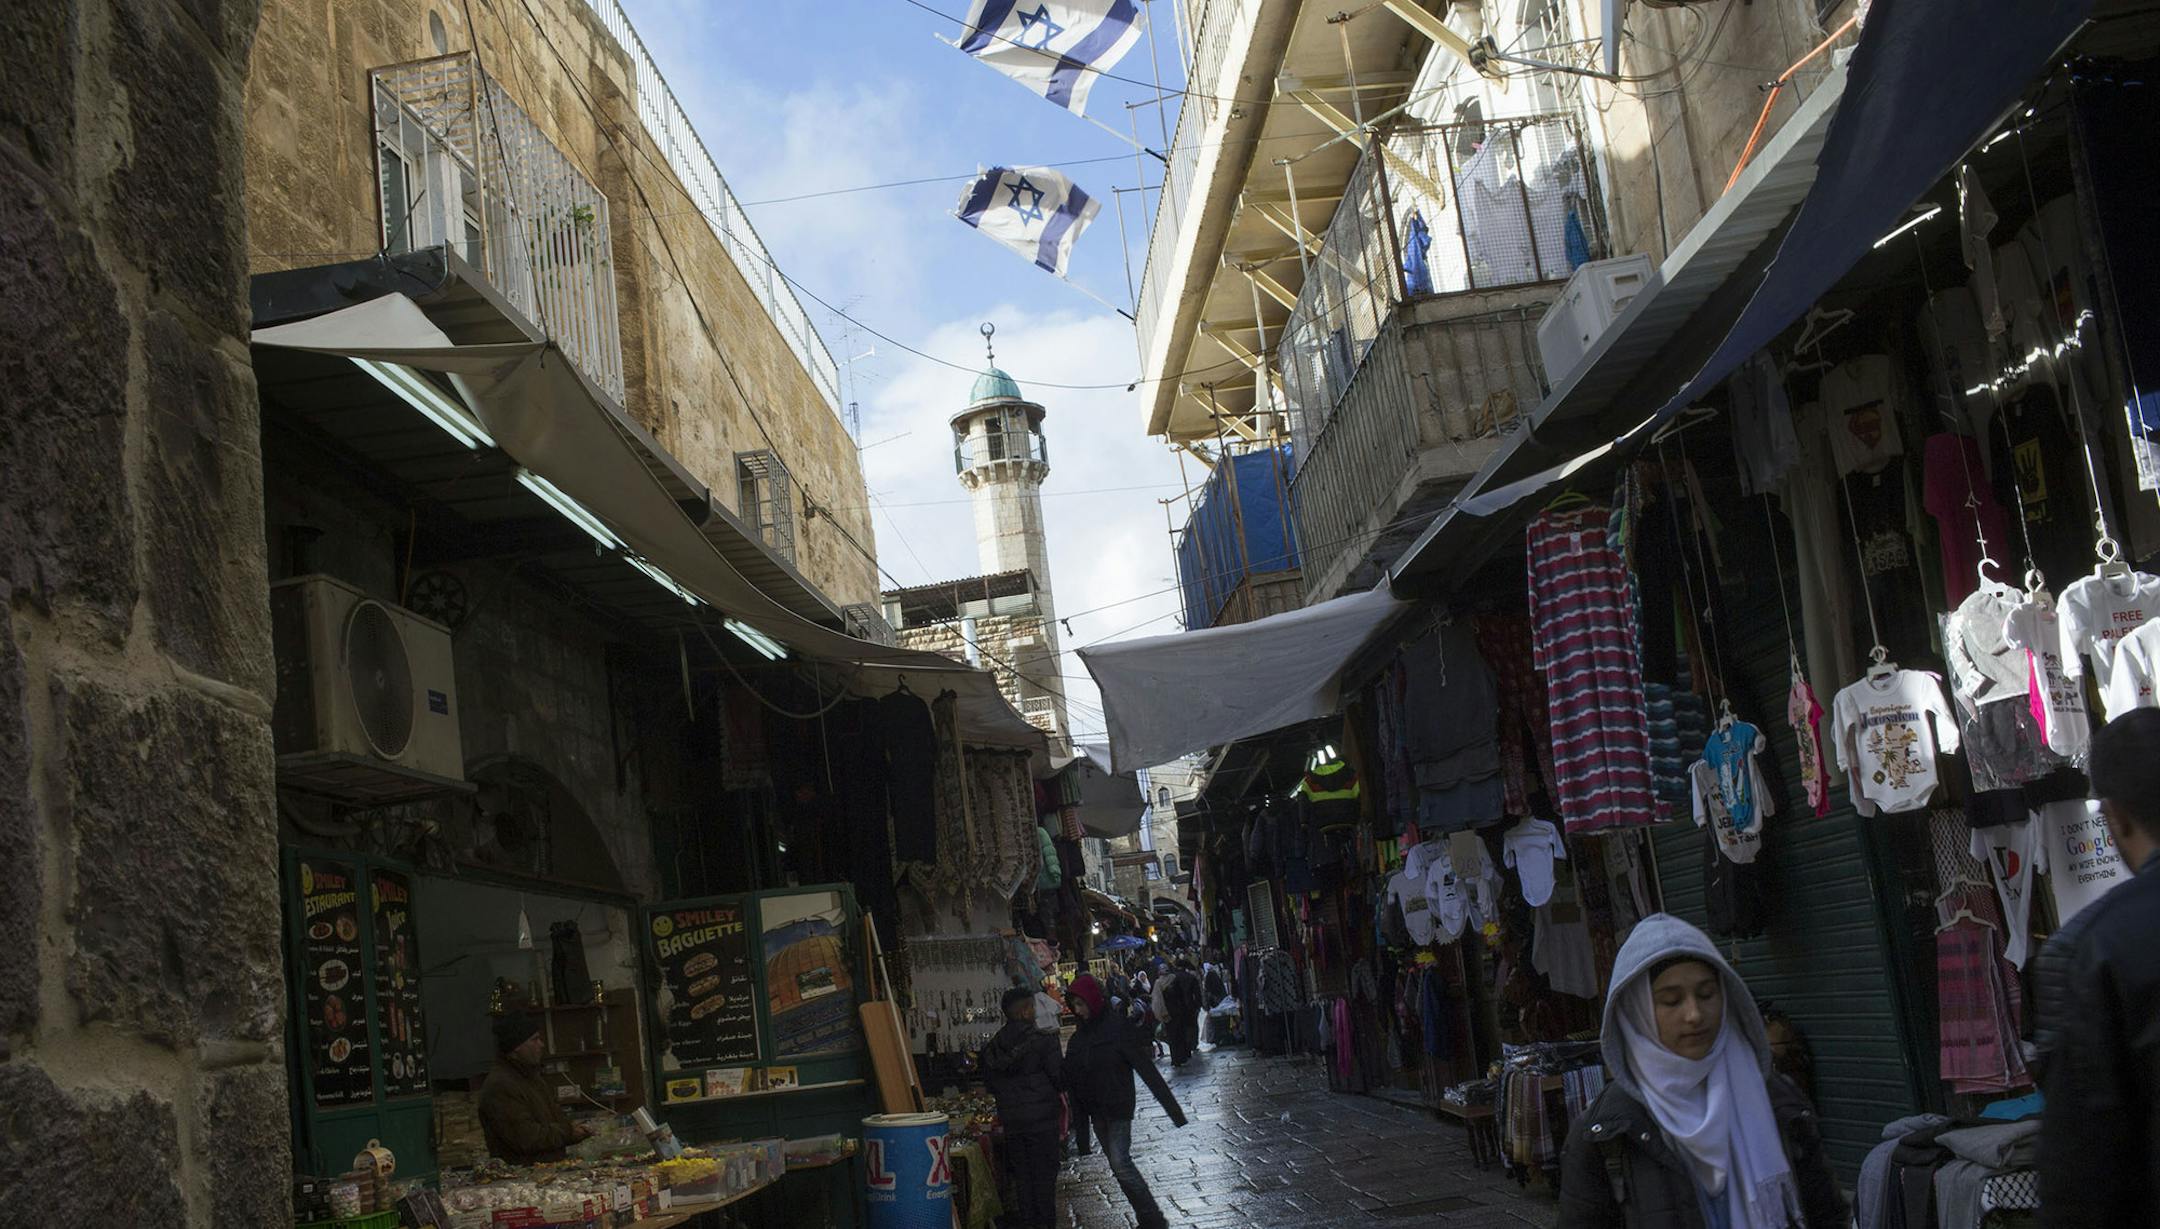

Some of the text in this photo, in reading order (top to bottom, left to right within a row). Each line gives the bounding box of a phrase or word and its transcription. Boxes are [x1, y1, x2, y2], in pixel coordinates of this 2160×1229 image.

[2112, 609, 2143, 622] FREE
[1870, 704, 1912, 715] Experience
[1861, 710, 1920, 730] Jerusalem
[2067, 820, 2090, 835] DON'T
[2091, 815, 2109, 828] NEE
[2066, 829, 2114, 857] Google
[2095, 853, 2121, 866] KNOWS
[314, 872, 346, 889] SMILEY
[2077, 868, 2116, 884] EVERYTHING
[376, 876, 408, 904] SMILEY
[305, 892, 355, 918] ESTAURANT
[675, 910, 736, 928] SMILEY
[658, 922, 744, 959] BAGUETTE
